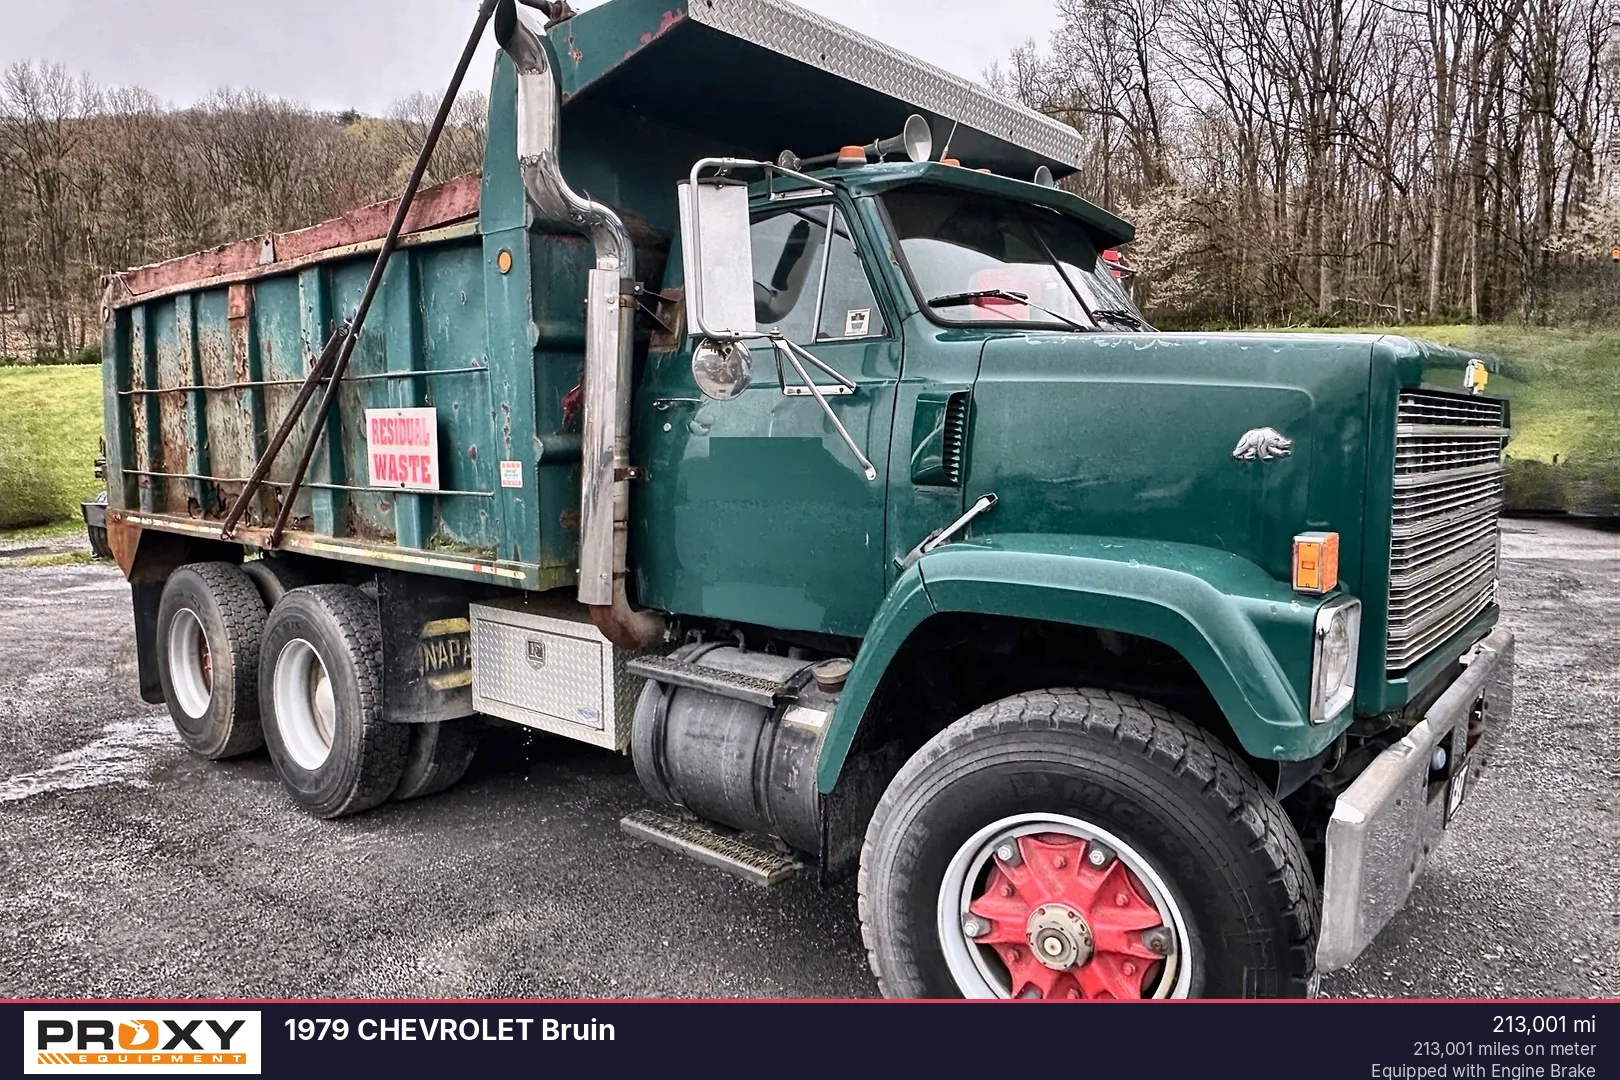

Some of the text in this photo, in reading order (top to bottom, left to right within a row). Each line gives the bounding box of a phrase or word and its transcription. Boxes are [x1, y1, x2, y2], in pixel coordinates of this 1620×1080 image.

[371, 417, 430, 447] RESIDUAL
[373, 453, 432, 484] WASTE
[422, 635, 471, 672] NAPA
